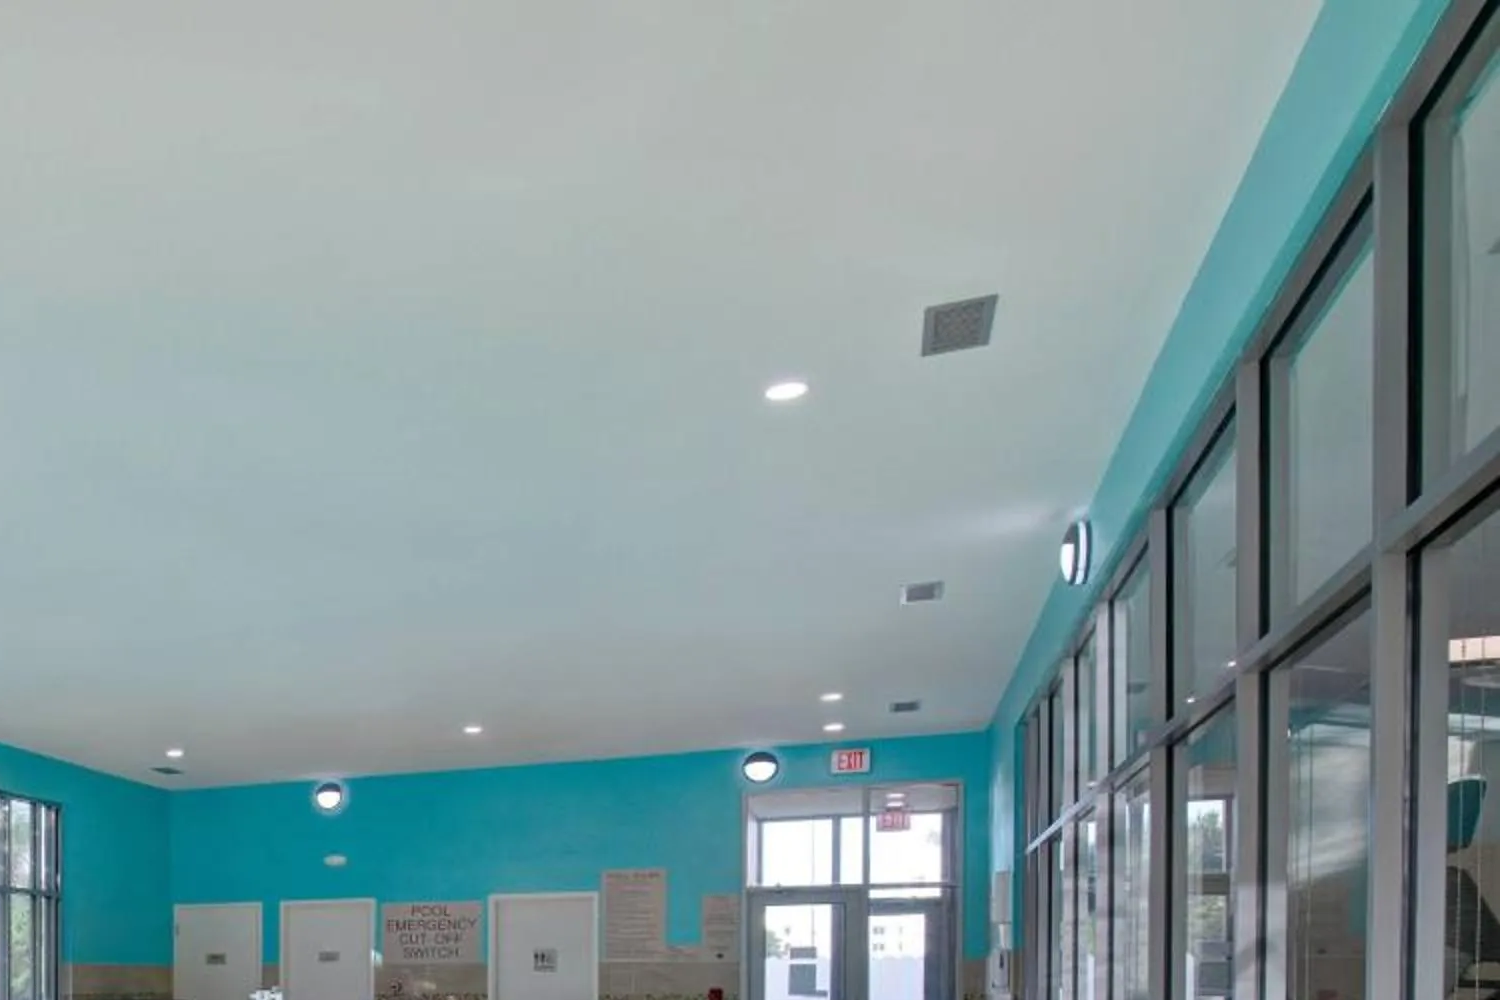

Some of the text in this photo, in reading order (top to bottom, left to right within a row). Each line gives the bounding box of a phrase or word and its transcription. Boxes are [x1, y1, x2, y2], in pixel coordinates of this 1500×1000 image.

[837, 751, 864, 770] EXIT
[411, 904, 451, 917] POOL
[386, 918, 478, 932] EMERGENCY
[400, 932, 426, 945] CUT
[402, 946, 461, 959] SWITCH
